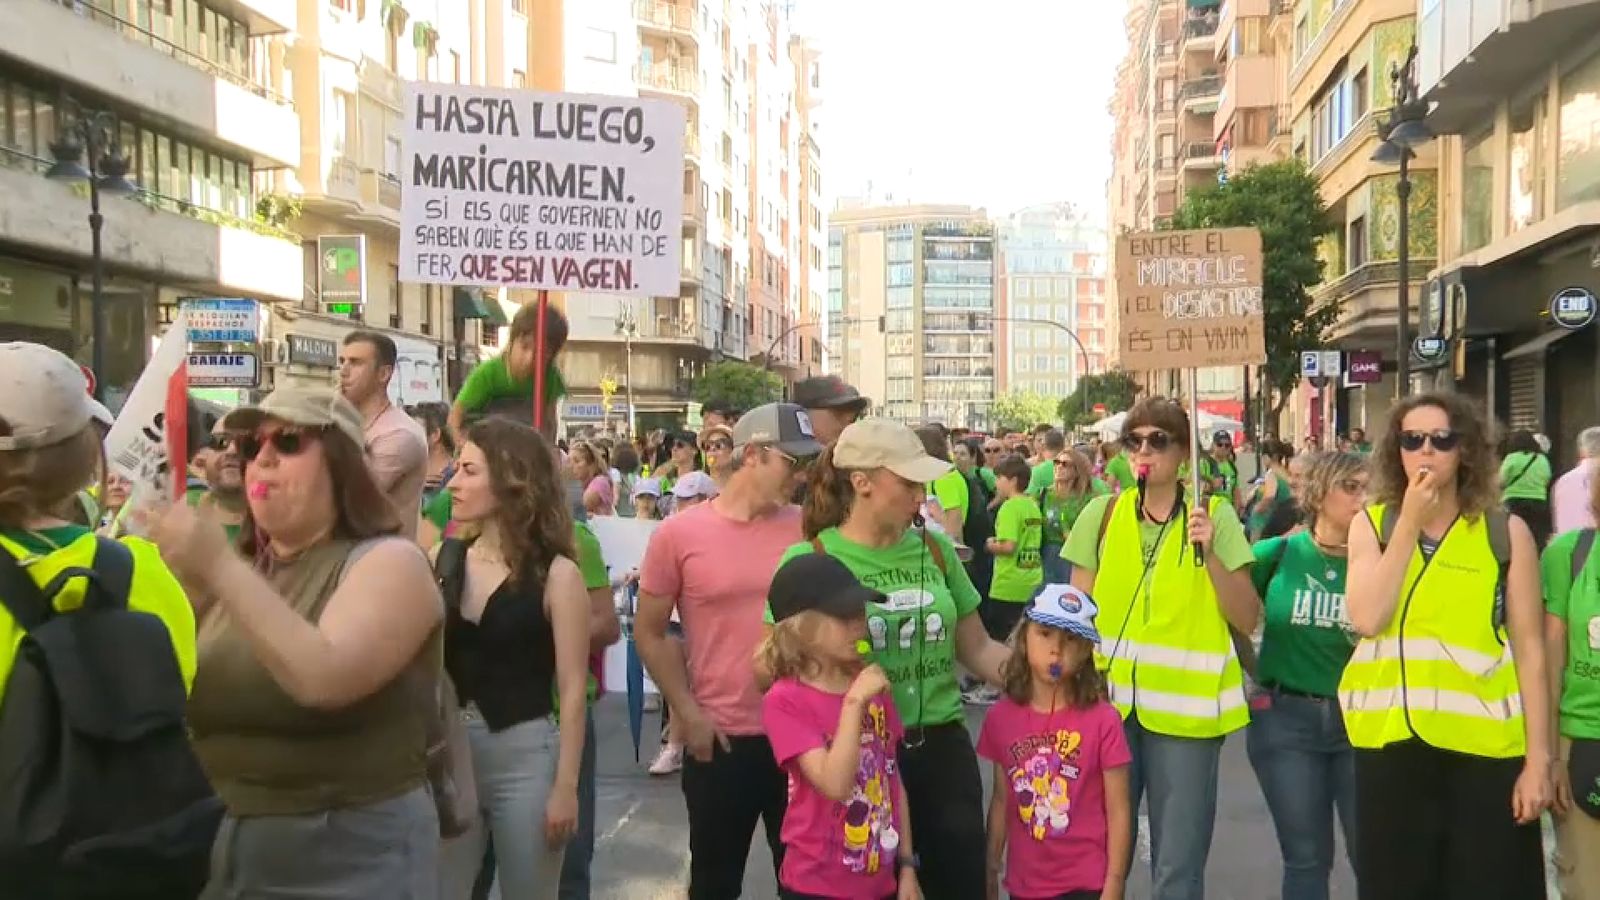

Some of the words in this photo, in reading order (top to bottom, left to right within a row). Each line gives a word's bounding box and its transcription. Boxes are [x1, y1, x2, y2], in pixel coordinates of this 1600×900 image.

[416, 94, 519, 137] HASTA
[533, 102, 656, 153] LUEGO,
[413, 144, 635, 204] MARICARMEN.
[464, 201, 491, 221] ELS
[500, 203, 529, 225] QUE
[539, 205, 627, 230] GOVERNEN
[636, 207, 663, 231] NO
[415, 224, 469, 248] SABEN
[509, 225, 528, 251] ÉS
[536, 231, 552, 250] EL
[555, 232, 586, 251] QUE
[593, 232, 633, 254] HAN
[641, 235, 668, 257] DE
[1130, 234, 1194, 256] ENTRE
[1206, 232, 1232, 254] EL
[417, 253, 457, 281] FER,
[460, 254, 497, 281] QUE
[552, 257, 640, 290] VAGEN.
[1136, 254, 1249, 286] MIRACLE
[1136, 296, 1156, 313] EL
[1167, 328, 1193, 352] ON
[1204, 326, 1249, 351] VIVIM
[189, 355, 245, 366] GARAJE
[1351, 362, 1380, 373] GAME
[1292, 588, 1312, 618] LA
